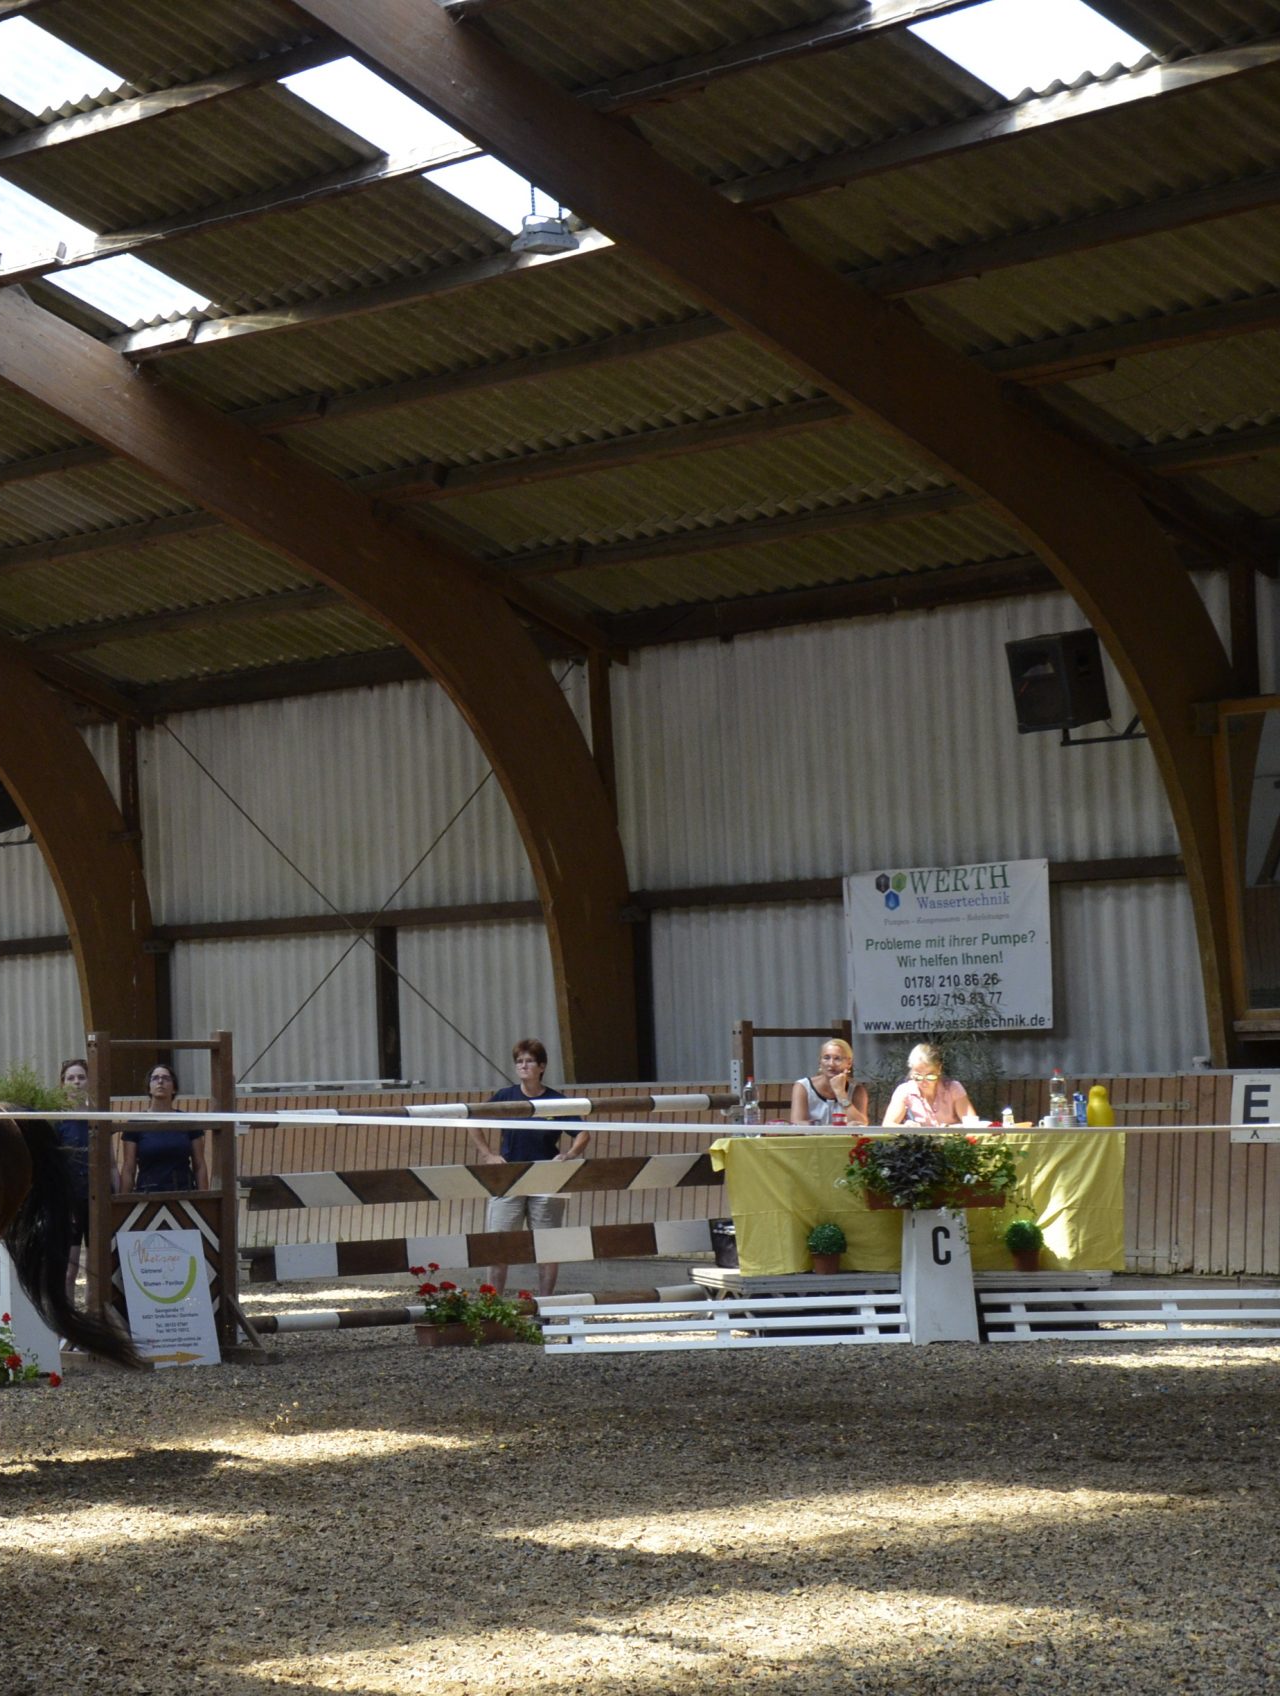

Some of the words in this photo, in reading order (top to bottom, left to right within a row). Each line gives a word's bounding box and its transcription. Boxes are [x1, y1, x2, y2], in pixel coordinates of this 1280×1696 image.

[909, 864, 1011, 894] WERTH
[916, 891, 1011, 910] Wassertechnik
[865, 936, 921, 951] Probleme
[925, 935, 945, 949] mit
[949, 934, 978, 947] ihrer
[981, 930, 1036, 946] Pumpe?
[897, 955, 916, 968] Wir
[920, 953, 959, 966] helfen
[962, 951, 1003, 965] Ihnen!
[904, 976, 935, 988] 0178/
[939, 974, 960, 987] 210
[964, 974, 979, 986] 86
[983, 973, 999, 986] 26
[901, 994, 940, 1007] 06152/
[944, 993, 965, 1006] 719
[988, 991, 1002, 1004] 77
[864, 1013, 1046, 1031] www.werth-wassertechnik.de
[1243, 1084, 1271, 1124] E
[932, 1226, 951, 1265] C
